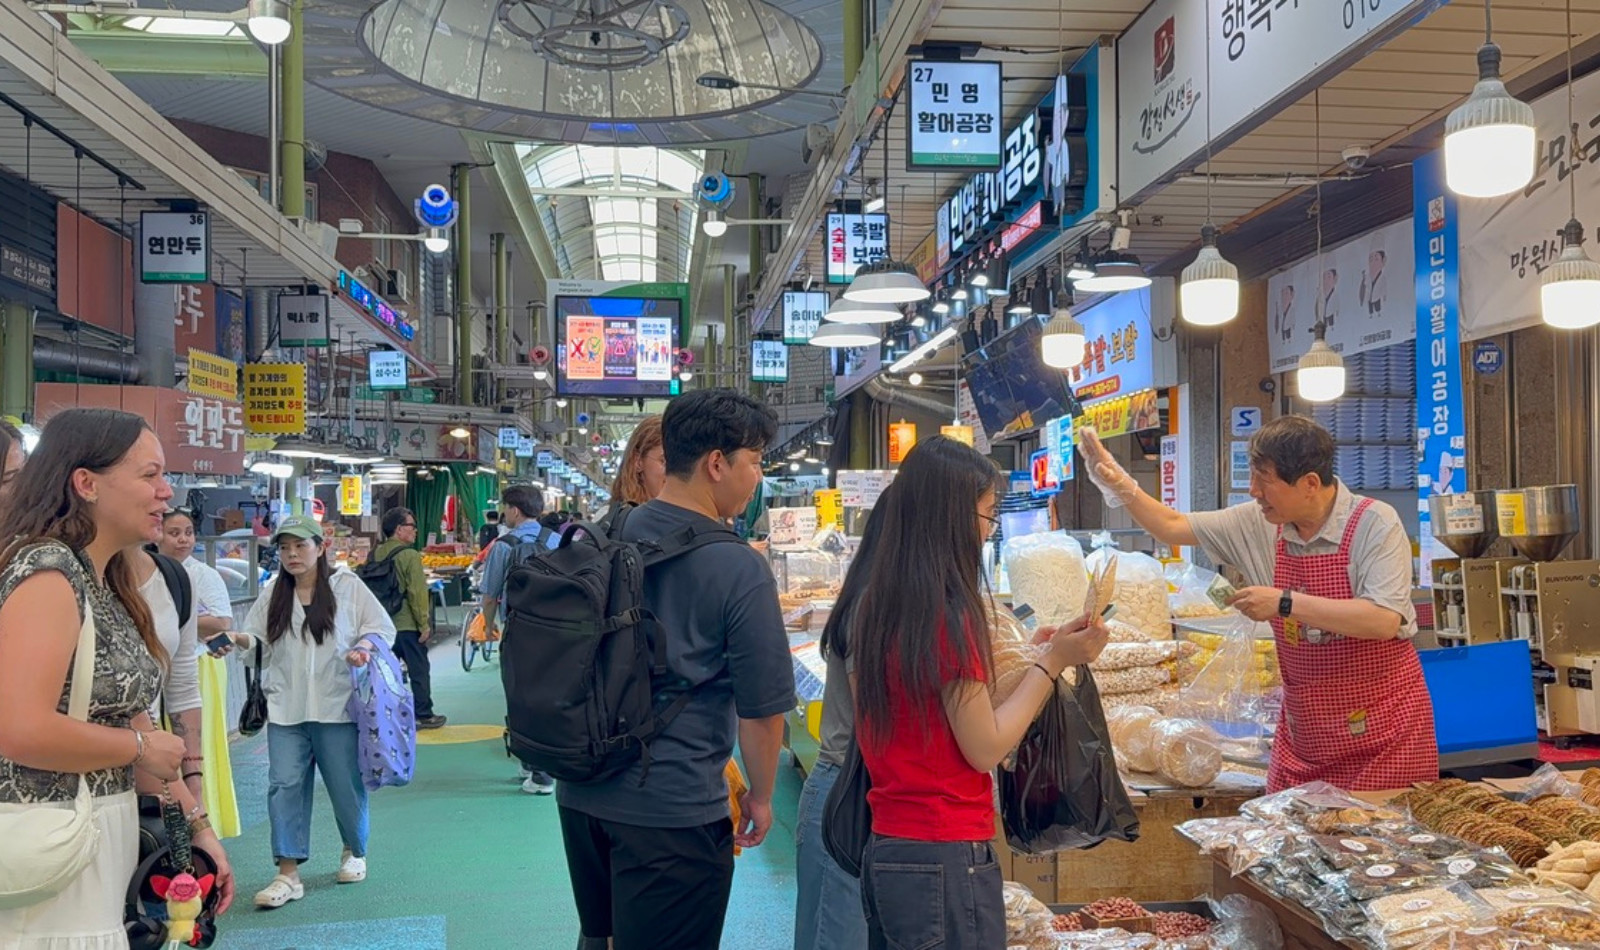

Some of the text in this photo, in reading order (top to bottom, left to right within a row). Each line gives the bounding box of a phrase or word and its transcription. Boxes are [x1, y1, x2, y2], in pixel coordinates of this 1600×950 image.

[1222, 0, 1298, 61] 행복
[914, 68, 933, 82] 27
[918, 111, 993, 133] 활어공장
[190, 214, 203, 225] 36
[148, 236, 202, 255] 연만두
[786, 295, 796, 304] 31
[1428, 234, 1450, 435] 민영활어공장
[1476, 351, 1498, 364] ADT
[185, 397, 245, 453] 연만두
[1545, 575, 1584, 583] BUNYOUNG
